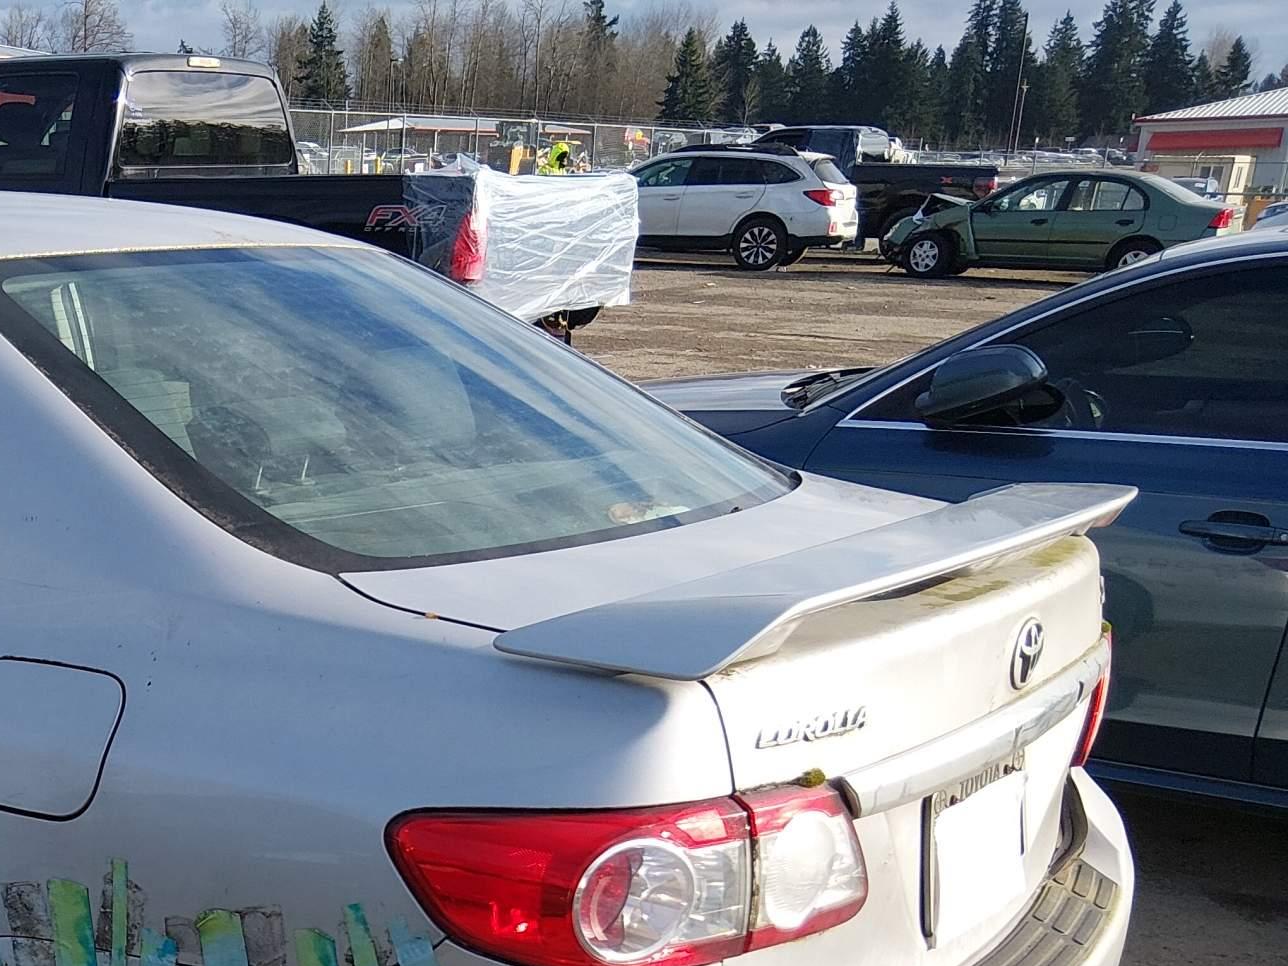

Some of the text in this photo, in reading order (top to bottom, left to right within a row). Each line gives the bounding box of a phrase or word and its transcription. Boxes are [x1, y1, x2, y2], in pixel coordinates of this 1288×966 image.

[365, 204, 448, 226] FX4
[754, 704, 867, 750] COROLLA
[959, 763, 1000, 802] TOYOTA
